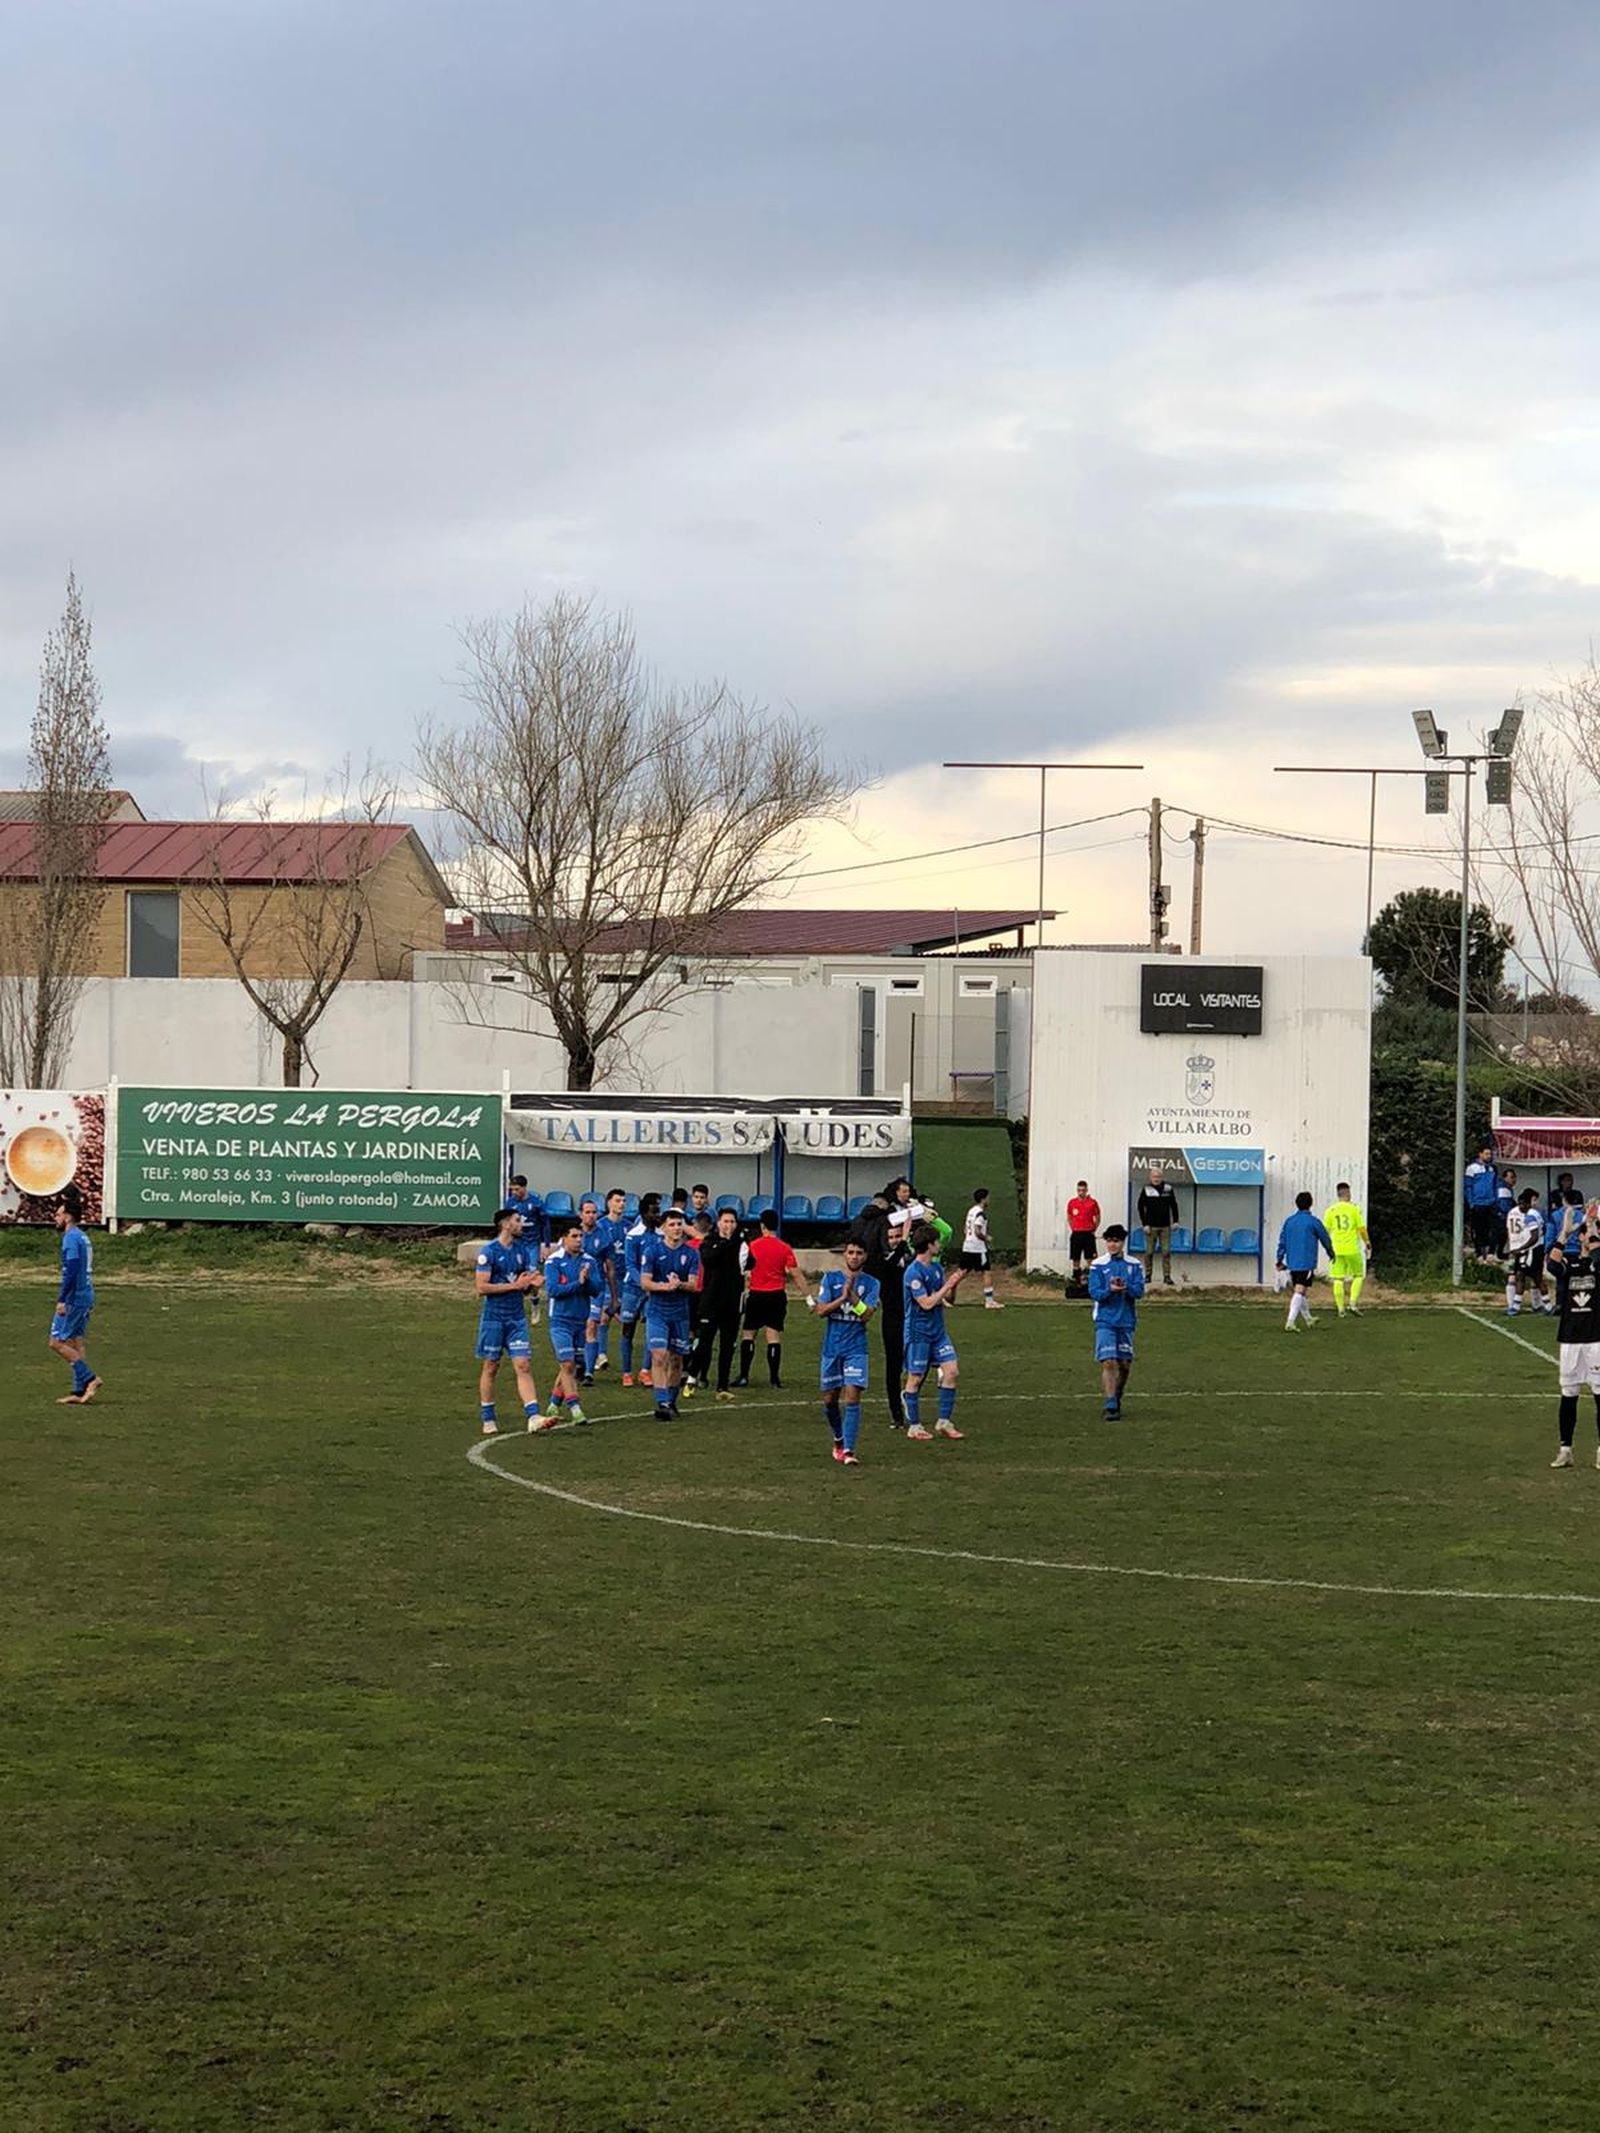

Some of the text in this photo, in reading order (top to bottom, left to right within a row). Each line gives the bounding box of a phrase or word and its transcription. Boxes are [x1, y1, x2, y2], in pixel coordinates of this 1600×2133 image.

[1153, 992, 1261, 1008] LOCAL VISITANTES
[142, 1101, 484, 1134] VIVEROS LA PERGOLA
[1147, 1108, 1252, 1119] AYUNTAMIENTO DE
[540, 1117, 722, 1145] TALLERES
[1147, 1120, 1252, 1136] VILLARALBO
[142, 1138, 482, 1160] VENTA DE PLANTAS Y JARDINERÍA
[1132, 1155, 1185, 1170] METAL
[141, 1167, 482, 1187] TELF.: 980 53 66 33 viveroslapergola@hotmail.com
[140, 1188, 481, 1209] Ctra. Moraleja, Km. 3 (junto rotonda) ZAMORA
[1335, 1213, 1350, 1231] 13
[1510, 1217, 1523, 1234] 15
